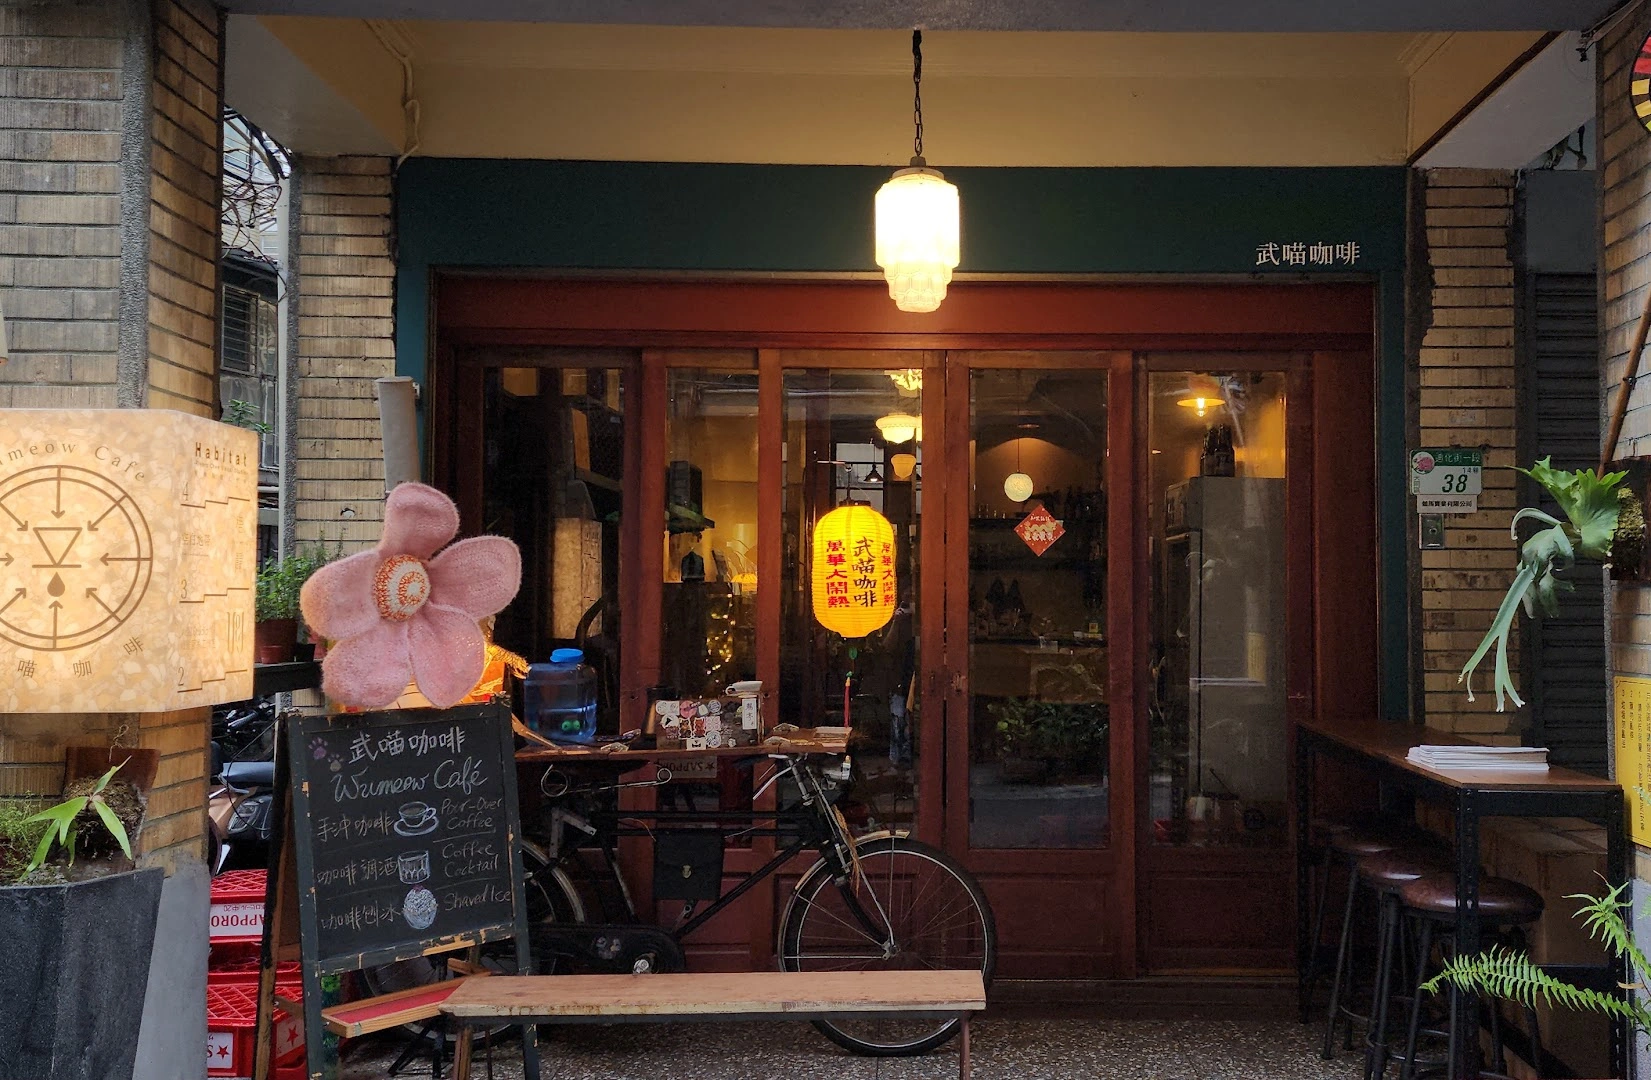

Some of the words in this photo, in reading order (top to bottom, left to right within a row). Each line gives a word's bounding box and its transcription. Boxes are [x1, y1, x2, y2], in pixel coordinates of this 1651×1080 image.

[1255, 241, 1361, 266] 武喵咖啡
[0, 442, 77, 466] meow
[94, 445, 145, 482] Cafe
[195, 441, 248, 468] Habitat
[182, 482, 189, 501] 4
[1442, 474, 1468, 493] 38
[852, 536, 878, 608] 武喵咖啡
[180, 579, 188, 600] 3
[177, 666, 185, 687] 2
[348, 726, 466, 765] 武喵咖啡
[330, 766, 430, 803] Wumeow
[433, 755, 489, 796] Café
[441, 797, 503, 816] Pour-Over
[447, 809, 494, 831] Coffee
[442, 841, 498, 859] Coffee
[317, 858, 399, 886] 咖啡調酒
[444, 853, 499, 878] Cocktail
[444, 883, 491, 912] Shaved
[491, 884, 512, 903] Ice
[211, 914, 265, 928] APPORO
[321, 898, 402, 931] 咖啡刨冰
